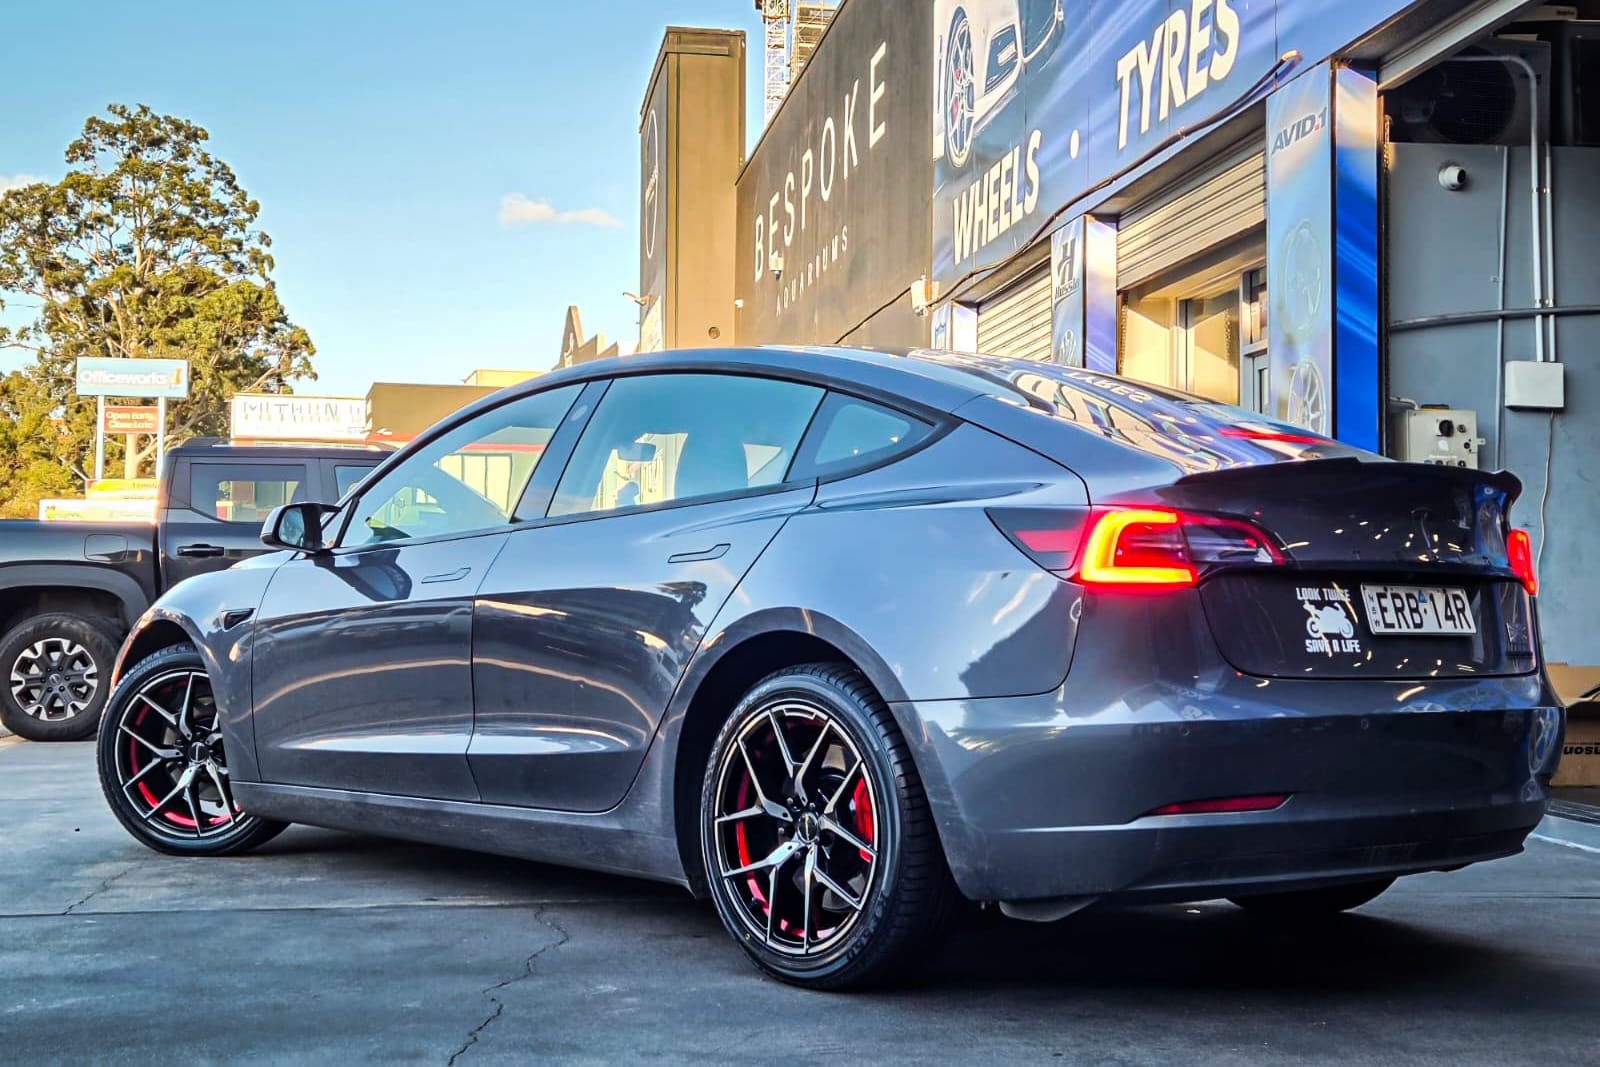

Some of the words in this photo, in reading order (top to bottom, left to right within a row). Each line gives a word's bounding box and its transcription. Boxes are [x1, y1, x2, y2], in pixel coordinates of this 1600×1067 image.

[754, 41, 886, 282] BESPOKE
[953, 129, 1041, 265] WHEELS
[776, 225, 848, 317] AQUARIUMS
[1296, 587, 1321, 601] LOOK
[1341, 640, 1361, 653] LIFE
